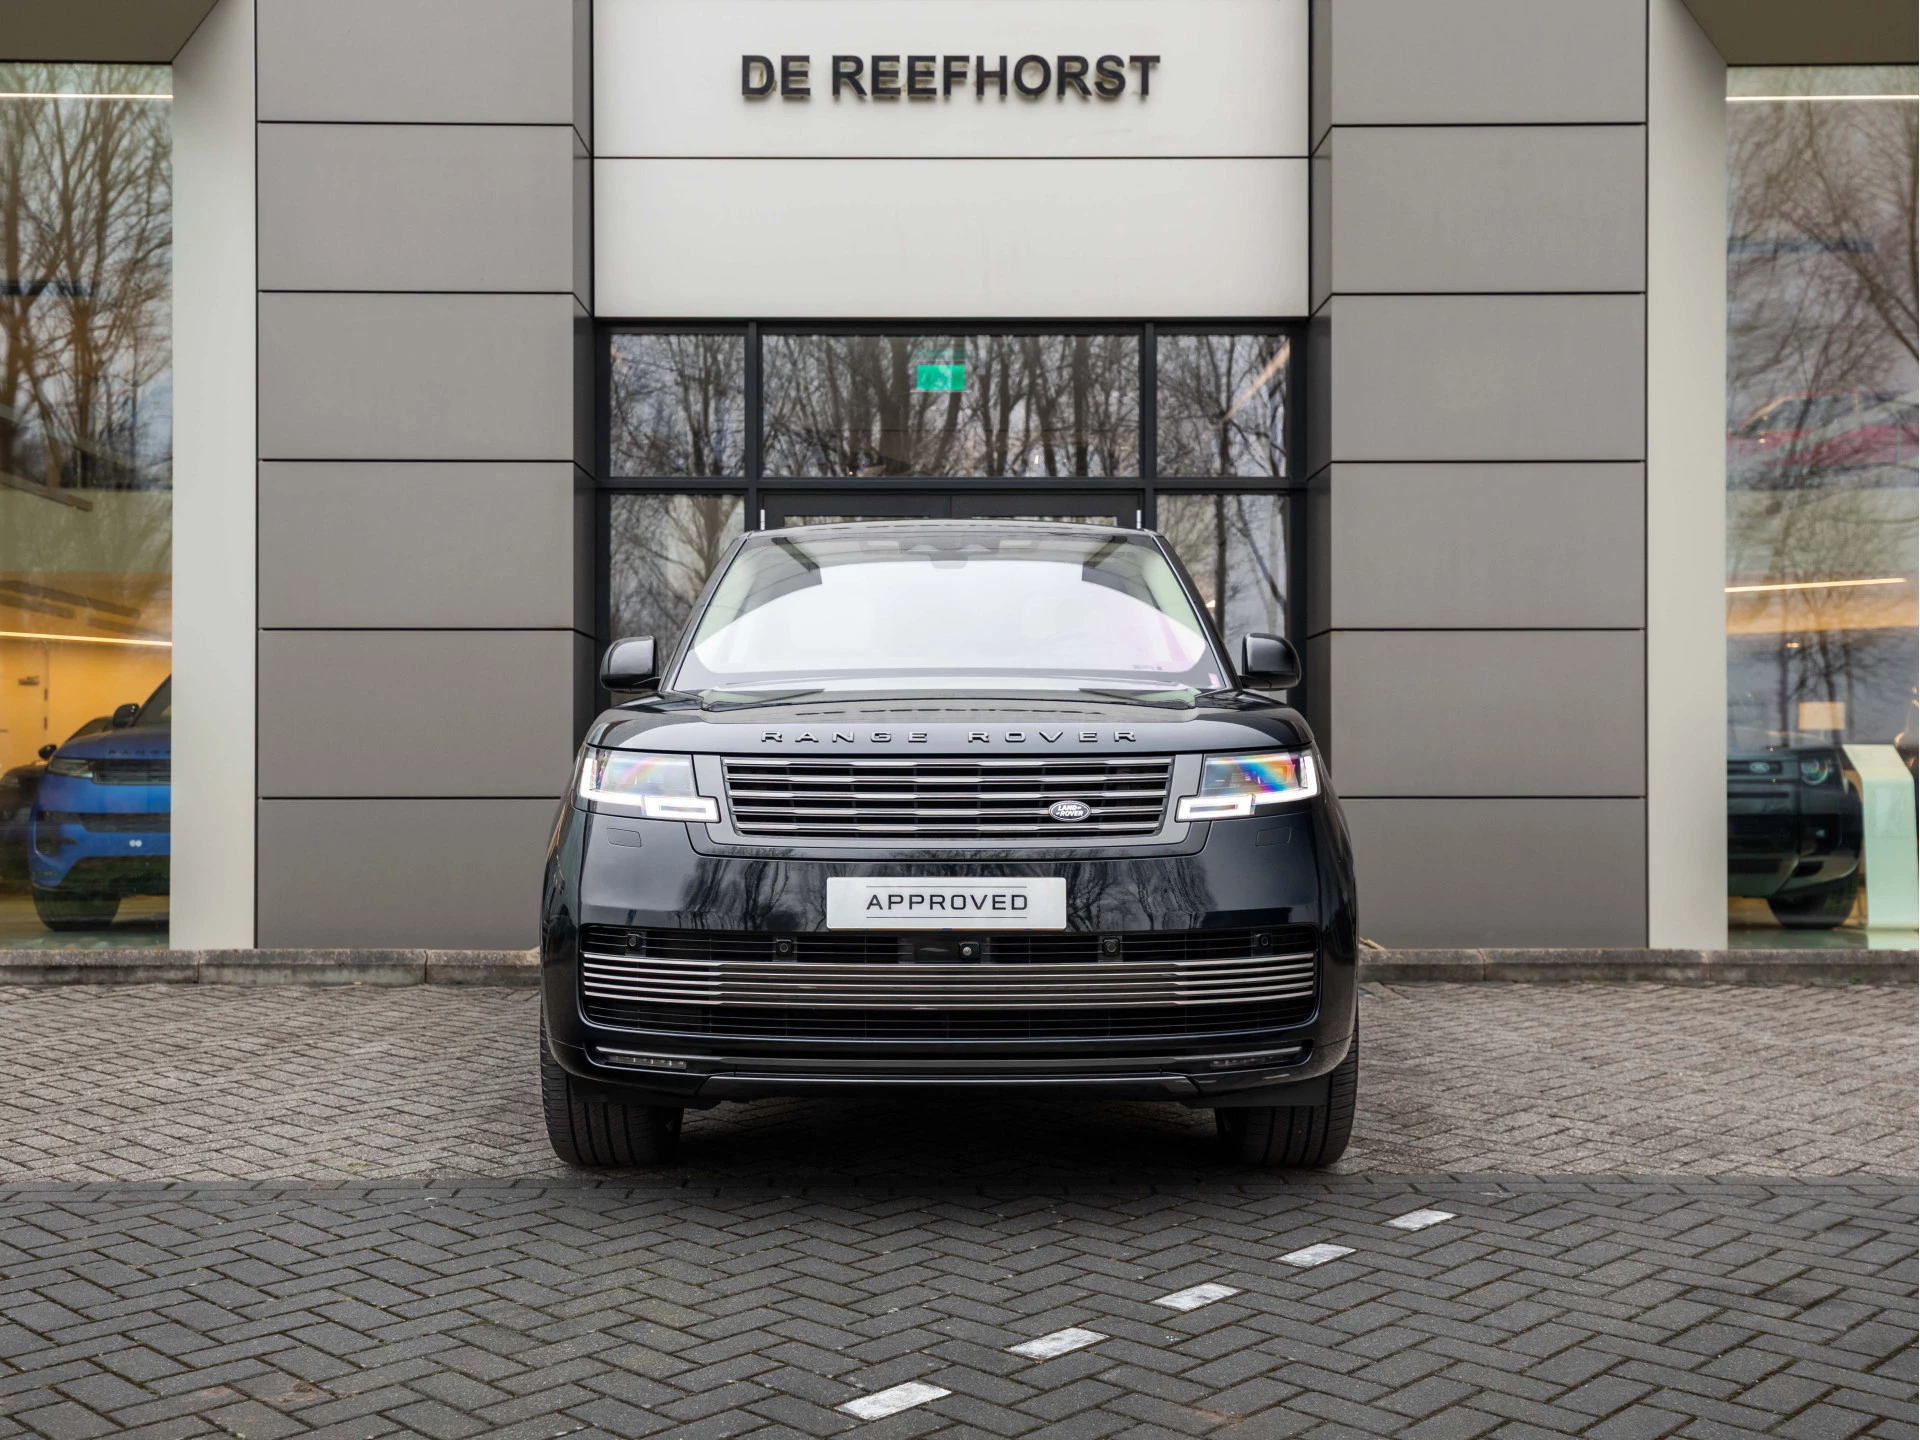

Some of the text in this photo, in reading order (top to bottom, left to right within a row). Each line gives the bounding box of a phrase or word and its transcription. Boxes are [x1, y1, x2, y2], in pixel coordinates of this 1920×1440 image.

[742, 55, 1161, 97] DE REEFHORST
[761, 731, 1136, 743] RANGE ROVER
[866, 894, 1028, 911] APPROVED
